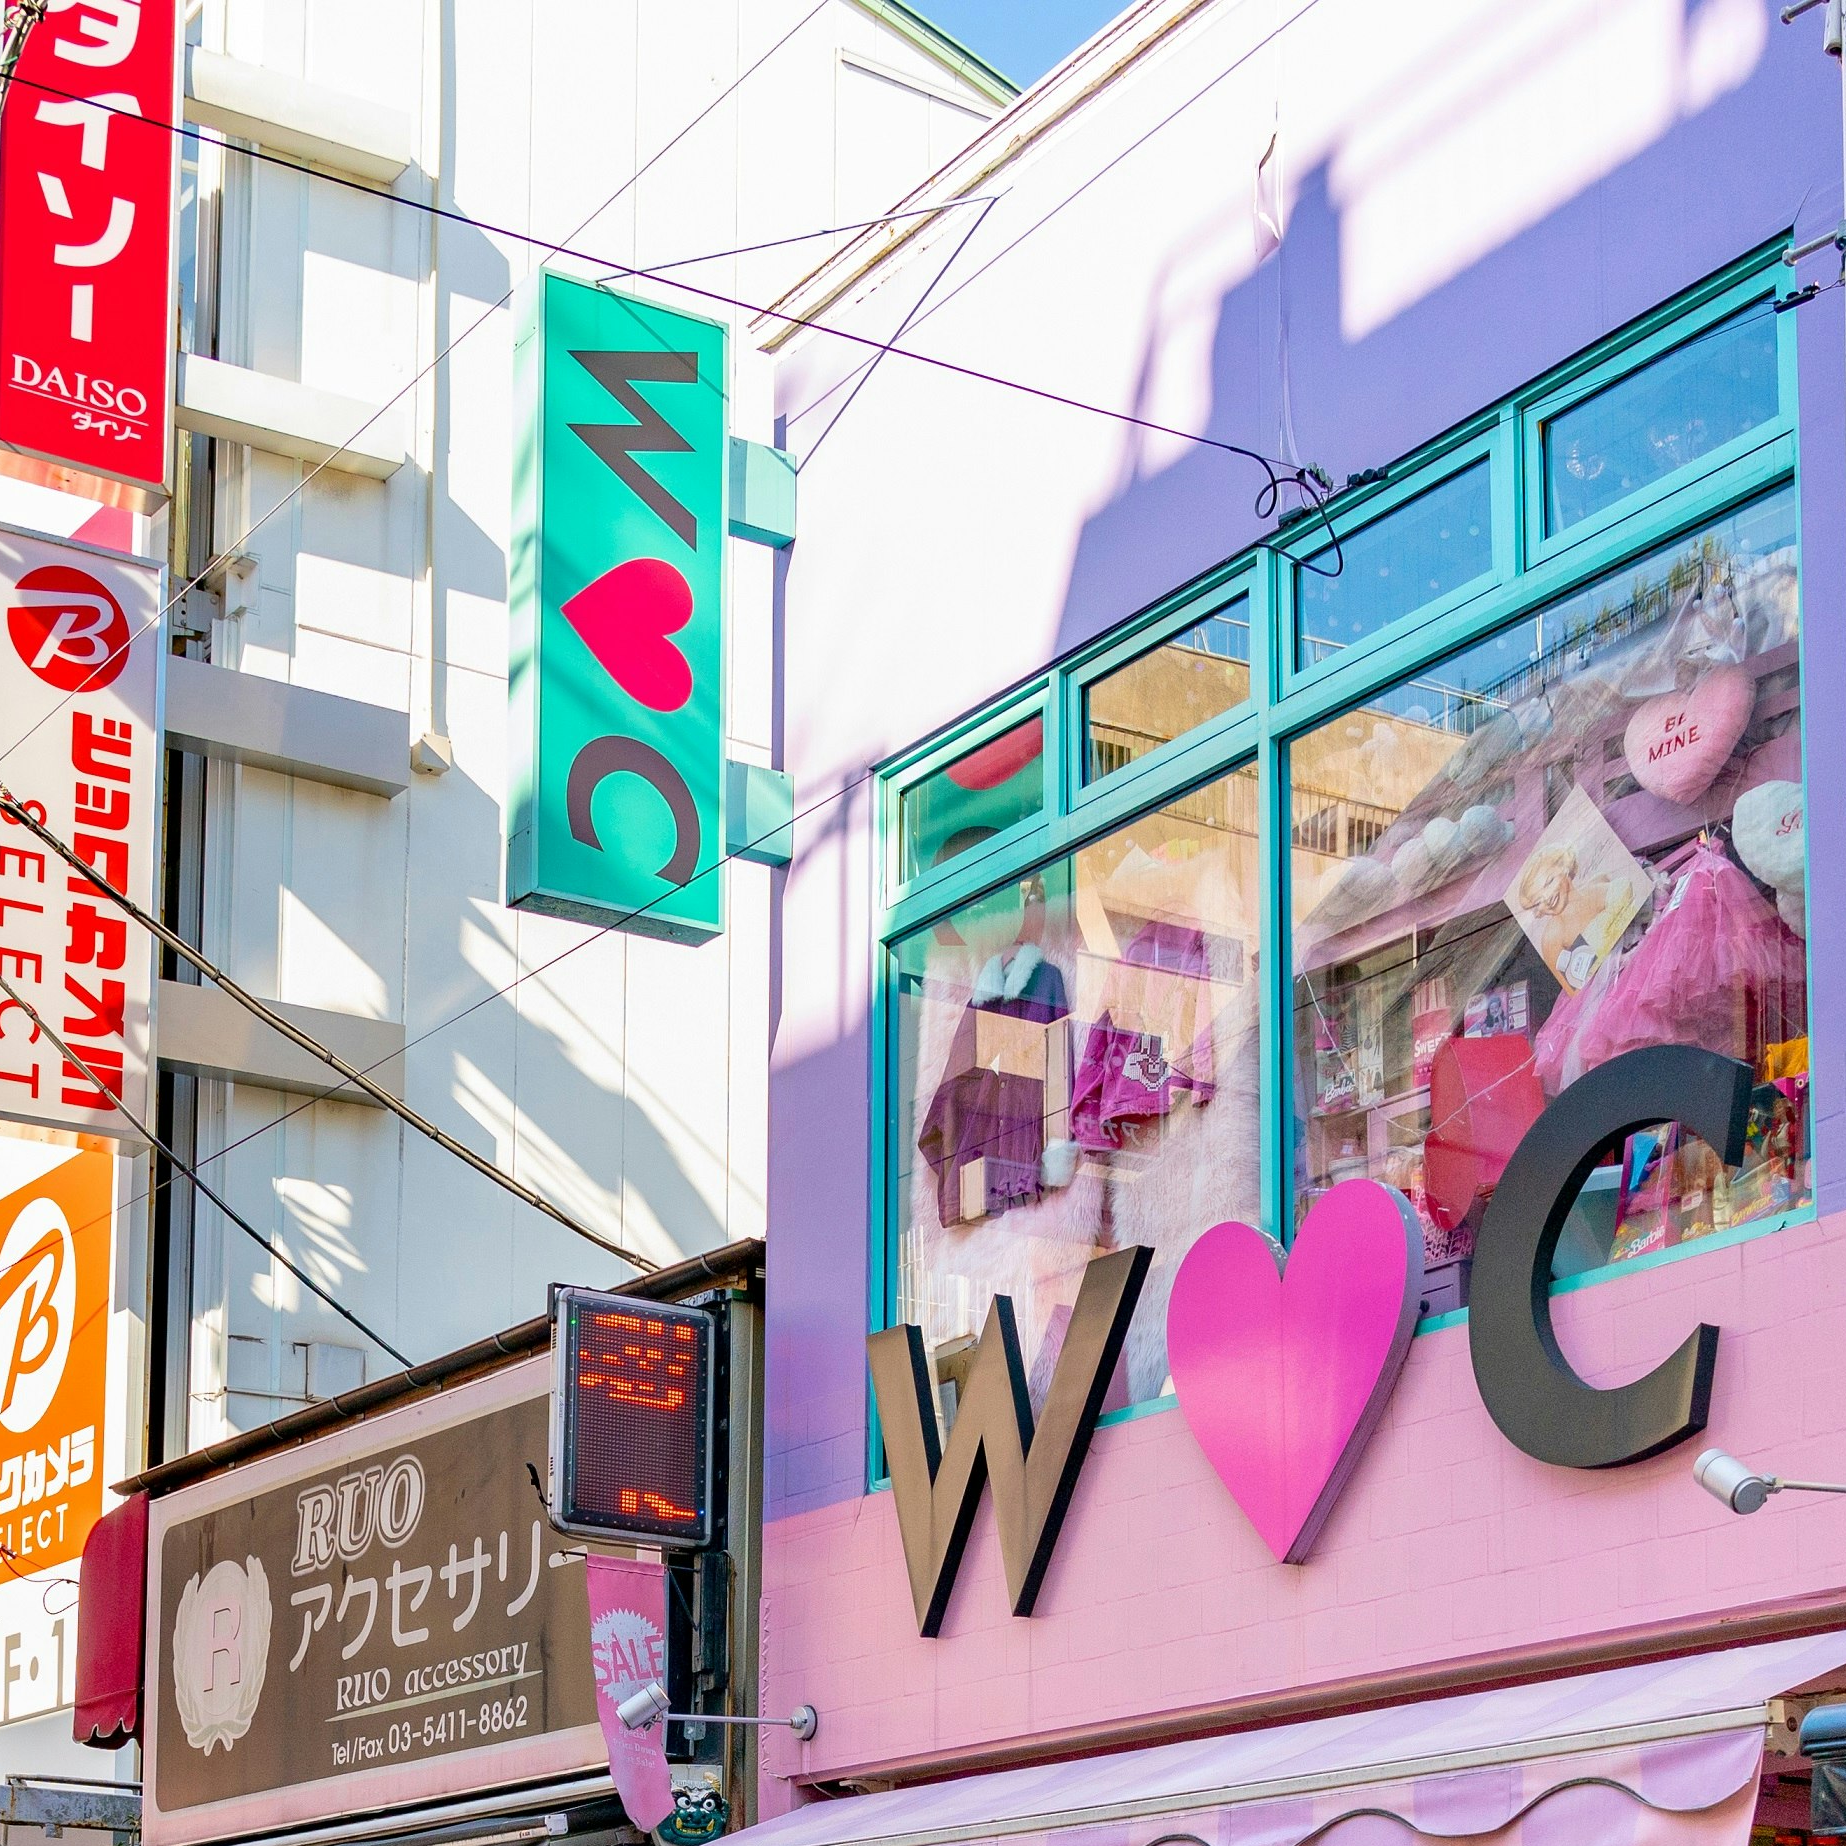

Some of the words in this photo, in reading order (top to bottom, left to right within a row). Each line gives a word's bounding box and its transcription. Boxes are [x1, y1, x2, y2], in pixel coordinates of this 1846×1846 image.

[10, 355, 148, 417] DAISO
[72, 411, 141, 442] ダイソー
[1649, 726, 1702, 764] MINE
[61, 712, 132, 1111] ビックカメラ
[1324, 1078, 1354, 1103] Barbie
[1628, 1224, 1665, 1258] Barbie
[867, 1245, 1154, 1638] W
[1468, 1045, 1754, 1469] C
[290, 1453, 425, 1578] RUO
[289, 1520, 589, 1673] アクセサリー
[335, 1667, 392, 1711] RUO
[404, 1641, 529, 1698] accessory
[592, 1632, 664, 1688] SALE
[330, 1736, 386, 1768] Tel/Fax
[387, 1697, 530, 1756] 03-5411-8862
